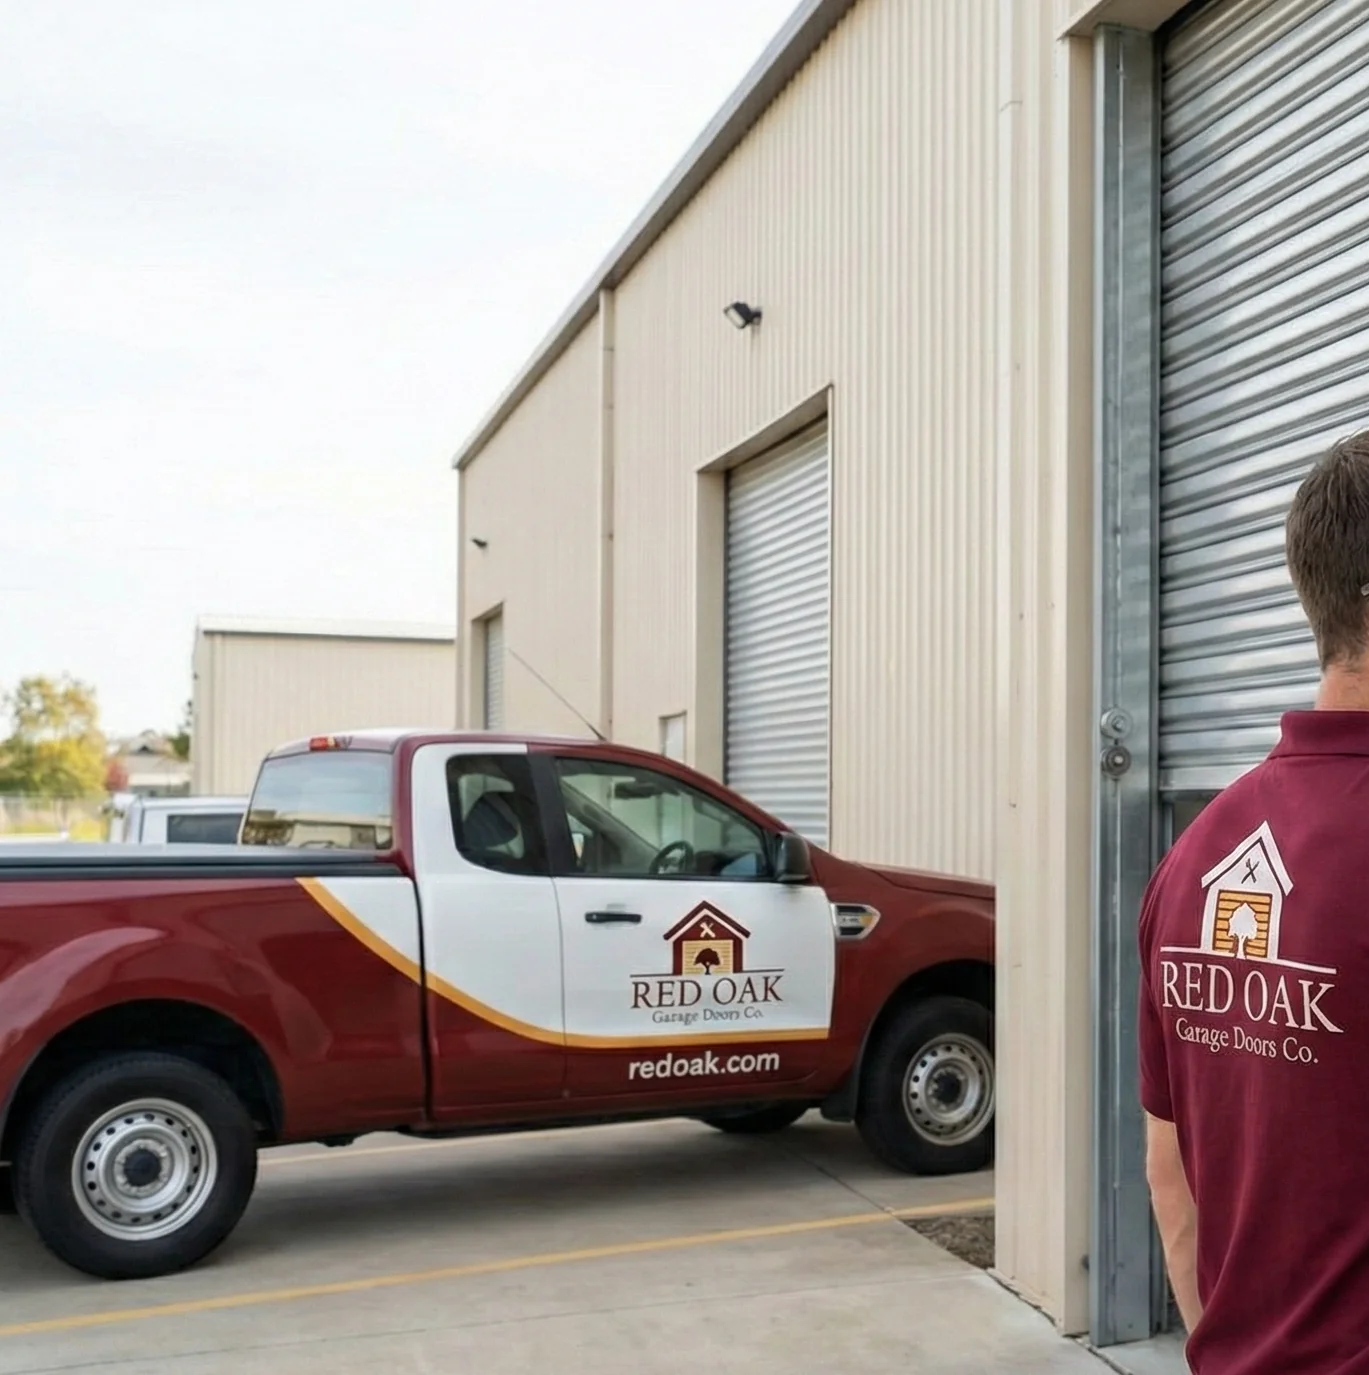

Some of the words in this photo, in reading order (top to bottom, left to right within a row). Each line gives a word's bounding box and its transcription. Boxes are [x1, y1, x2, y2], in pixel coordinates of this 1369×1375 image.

[631, 980, 701, 1008] RED
[713, 975, 783, 1005] OAK
[1160, 961, 1235, 1013] RED
[1243, 969, 1344, 1033] OAK
[652, 1010, 699, 1025] Garage
[1175, 1017, 1229, 1053] Garage
[1233, 1026, 1277, 1058] Doors
[1282, 1038, 1319, 1064] Co.
[628, 1050, 780, 1080] redoak.com
